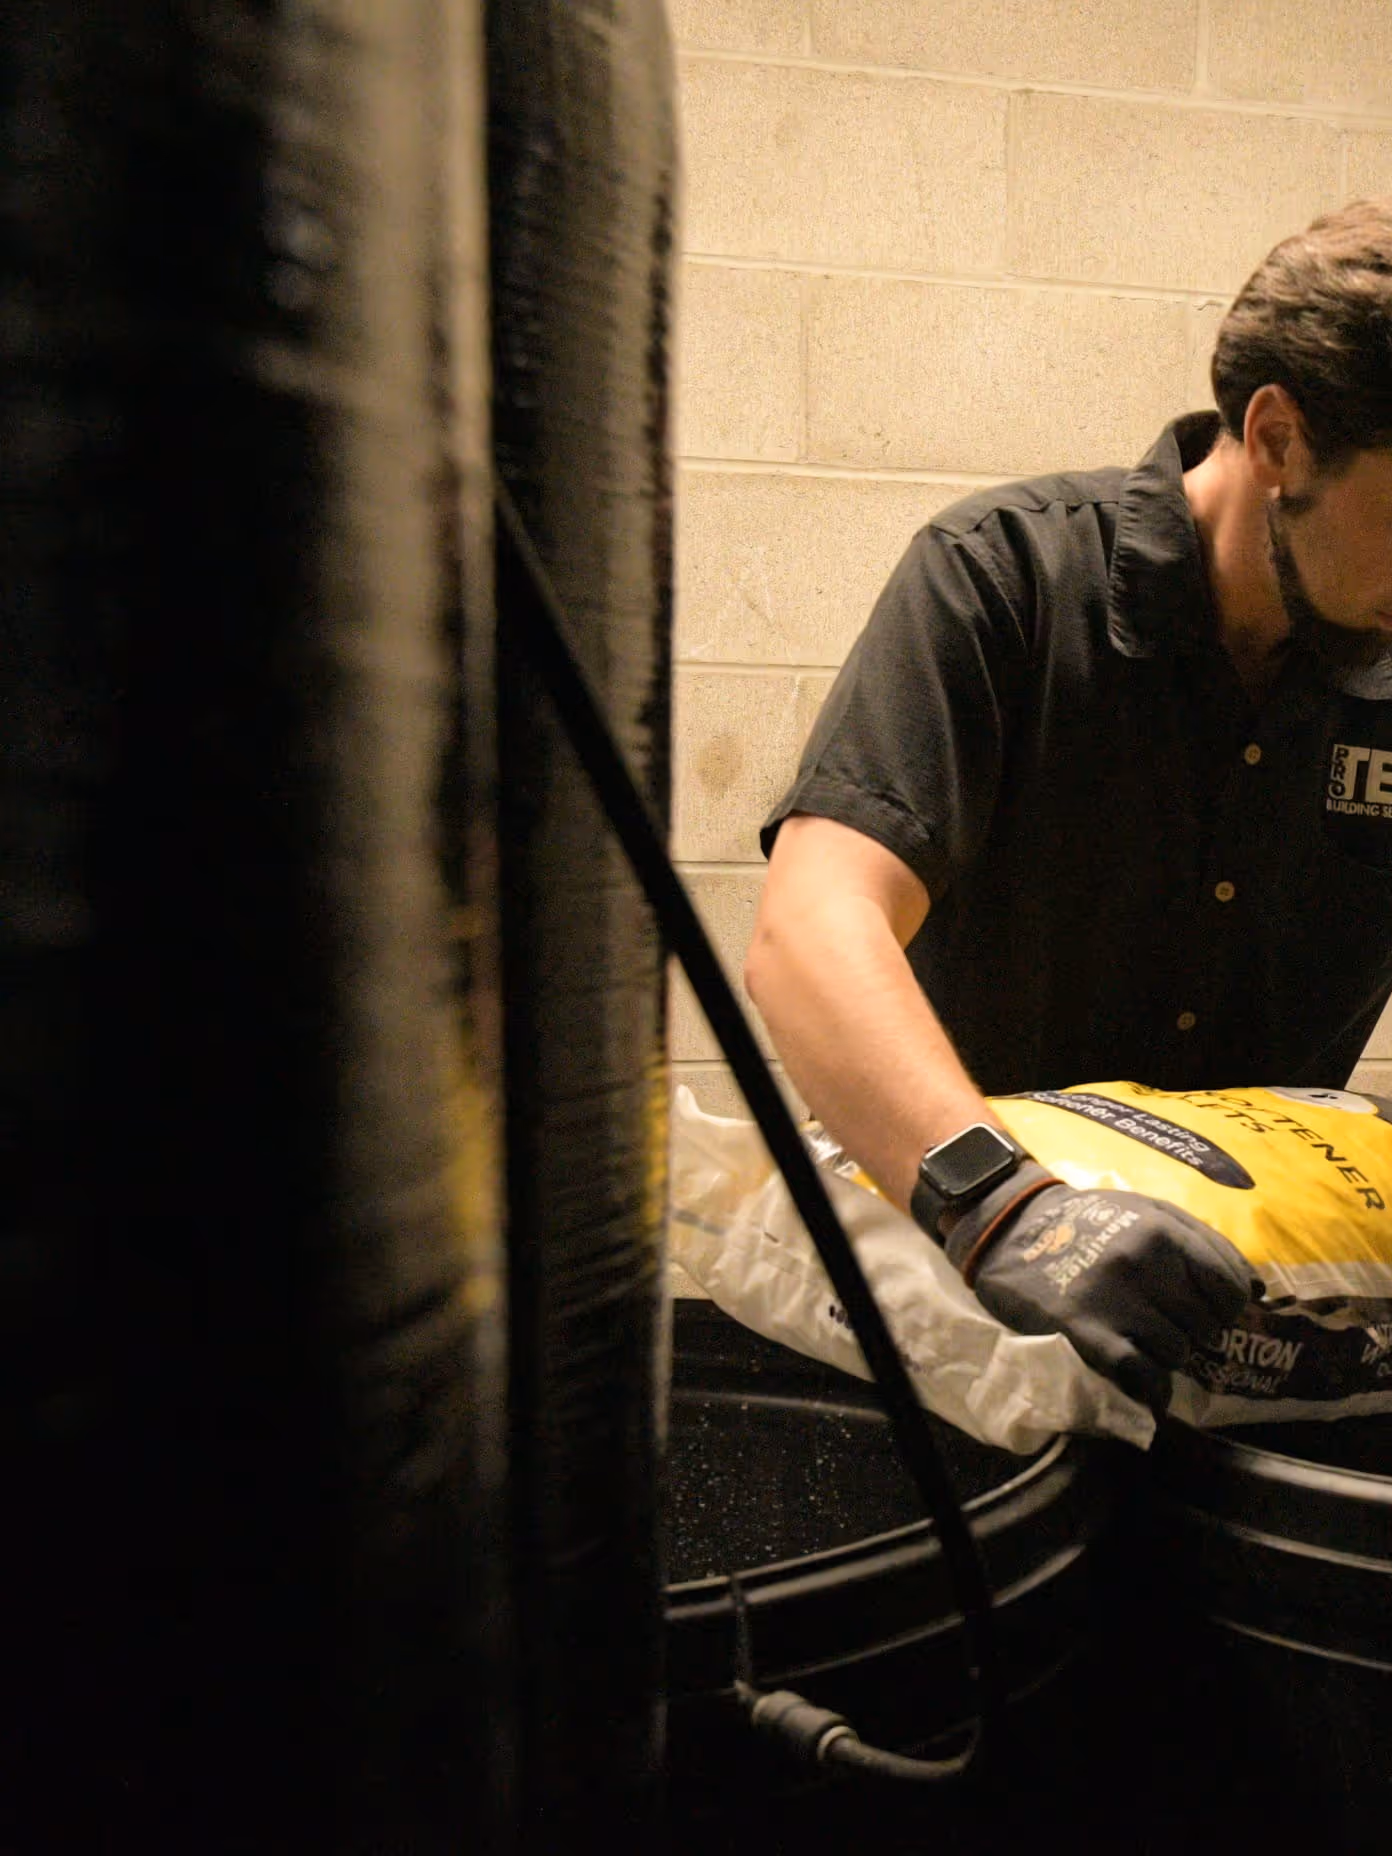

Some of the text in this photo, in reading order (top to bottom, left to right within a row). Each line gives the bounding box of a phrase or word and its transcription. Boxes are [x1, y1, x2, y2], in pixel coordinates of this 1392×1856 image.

[1328, 746, 1350, 799] PRO
[1326, 798, 1380, 817] BUILDING
[1114, 1117, 1204, 1166] Benefits
[1132, 1112, 1211, 1152] Lasting
